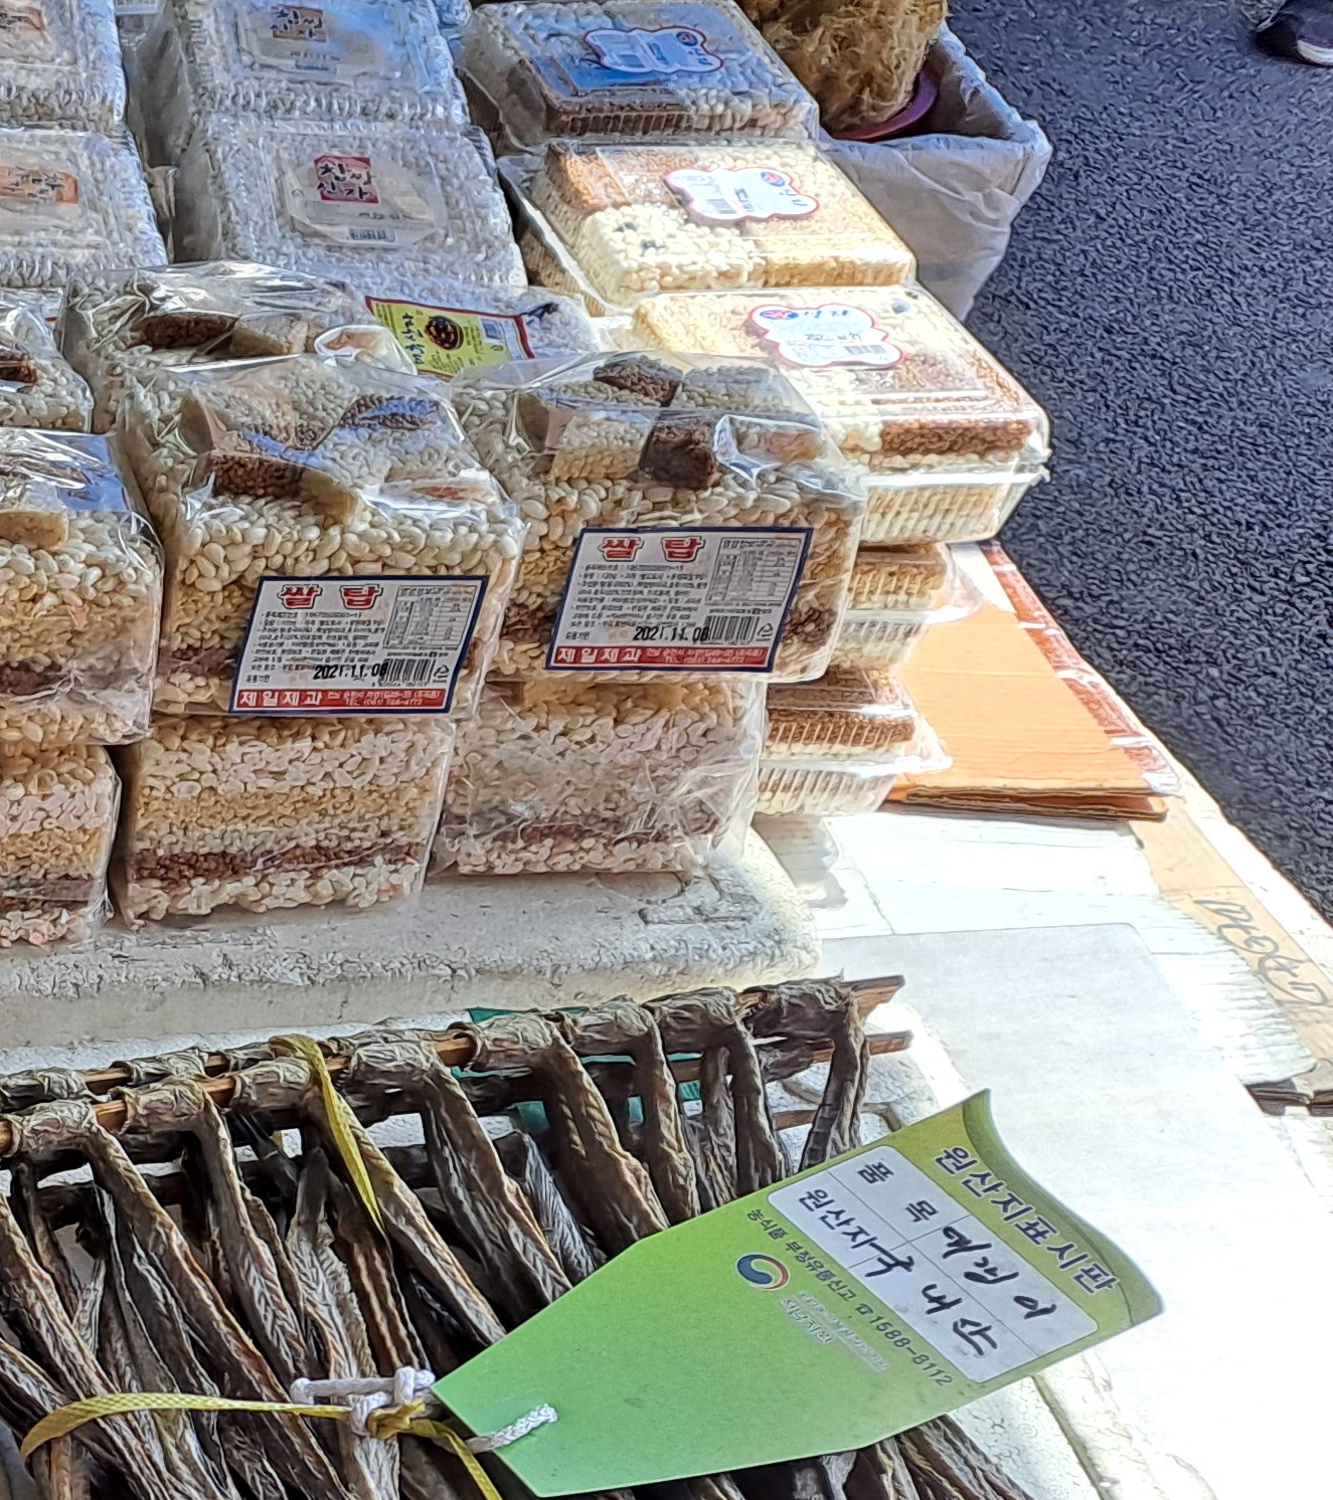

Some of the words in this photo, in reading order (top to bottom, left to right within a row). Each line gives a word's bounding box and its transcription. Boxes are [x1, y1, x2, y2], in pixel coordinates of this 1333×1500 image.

[599, 536, 645, 562] 쌀
[278, 583, 322, 610] 쌀
[239, 690, 323, 707] 제일제과
[798, 1189, 878, 1249] 원산지
[935, 1146, 1118, 1293] 원산지표시판
[746, 1209, 788, 1240] 농식품
[785, 1241, 857, 1301] 부정유통신고
[869, 1315, 953, 1386] 1588-8112
